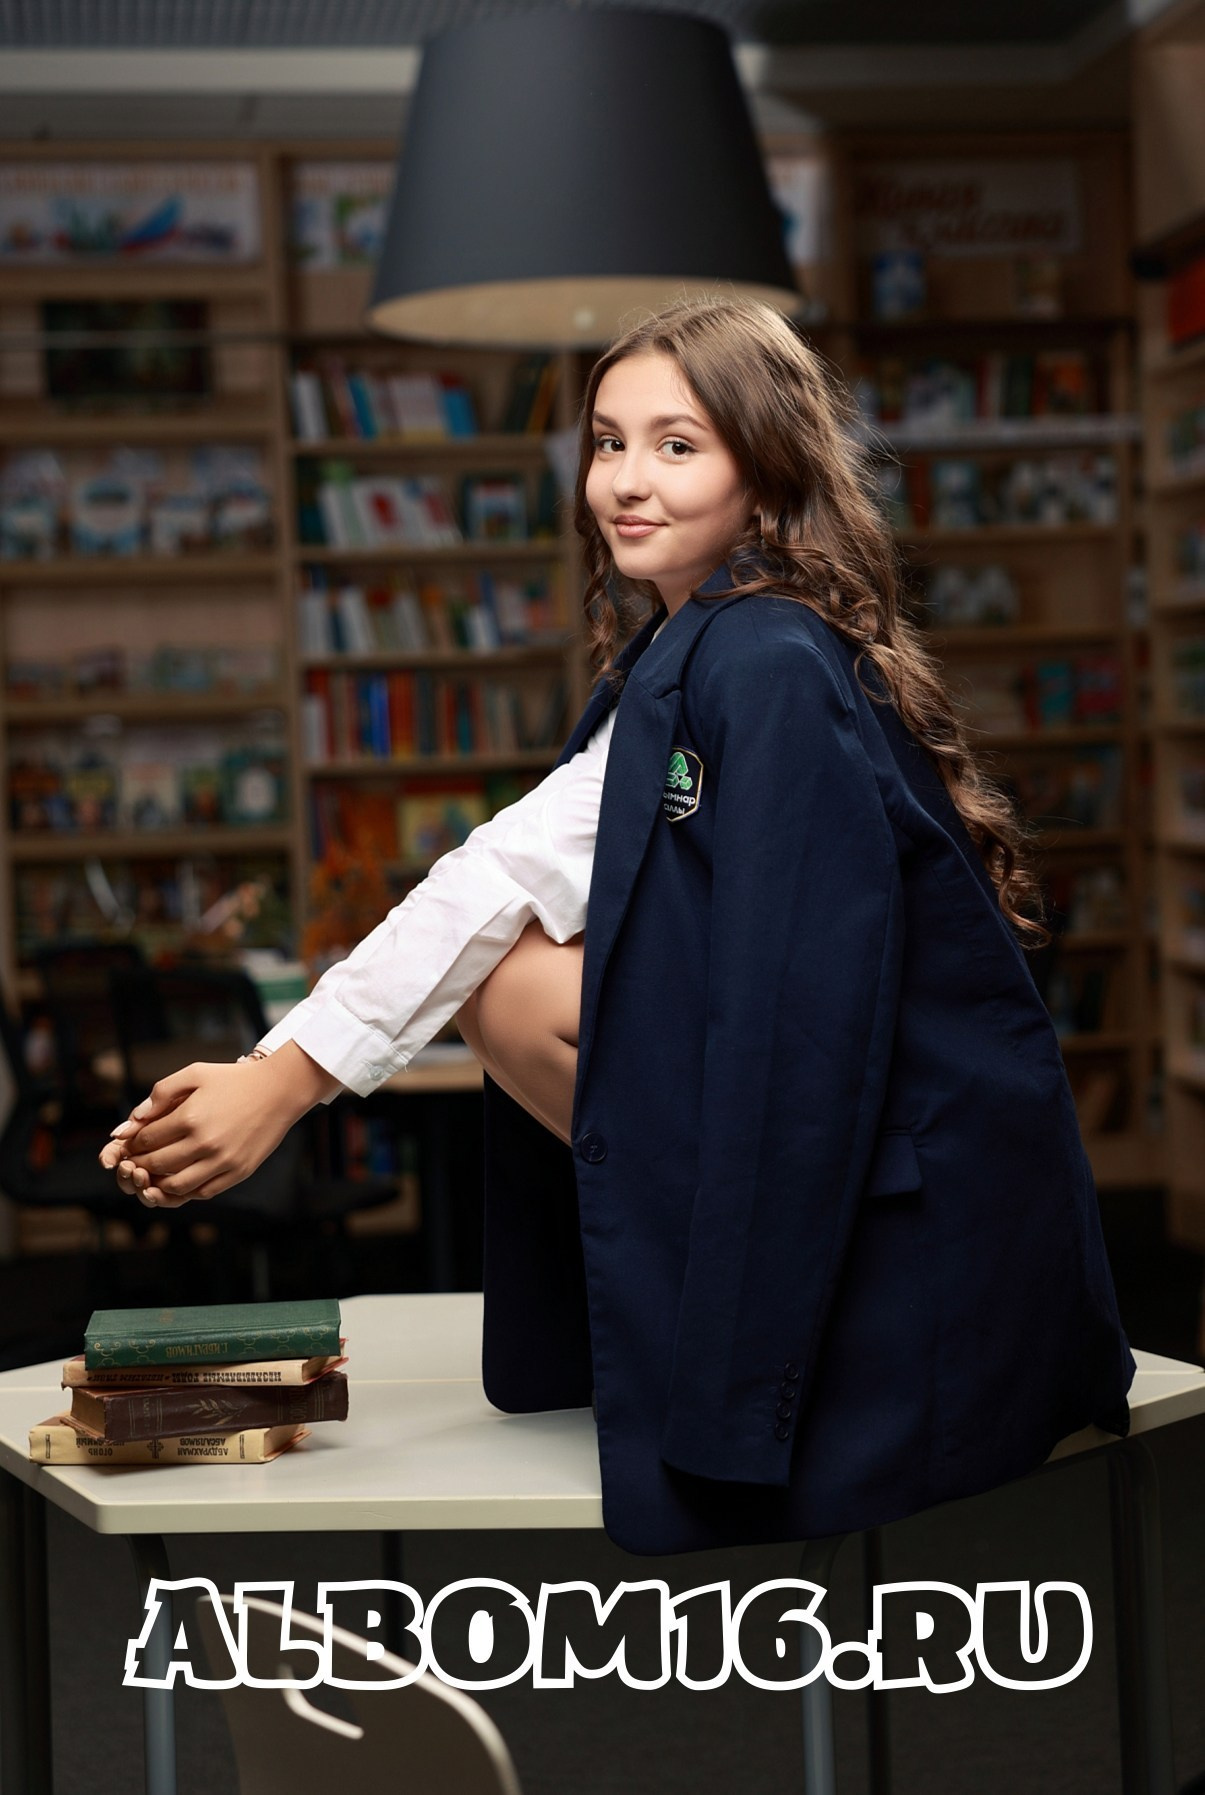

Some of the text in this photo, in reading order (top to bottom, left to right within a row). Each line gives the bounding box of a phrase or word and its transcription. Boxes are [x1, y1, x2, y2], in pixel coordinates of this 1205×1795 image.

[663, 792, 696, 807] ымнар
[165, 1342, 221, 1358] ИБРАГИМОВ
[171, 1371, 200, 1383] ГОДЫ
[203, 1371, 282, 1383] НЕЗАБЫВАЕМЫЕ
[180, 1437, 226, 1447] АБСАЛЯМОВ
[88, 1447, 113, 1456] ОГОНЬ
[177, 1447, 229, 1456] АБДУРАХМАН
